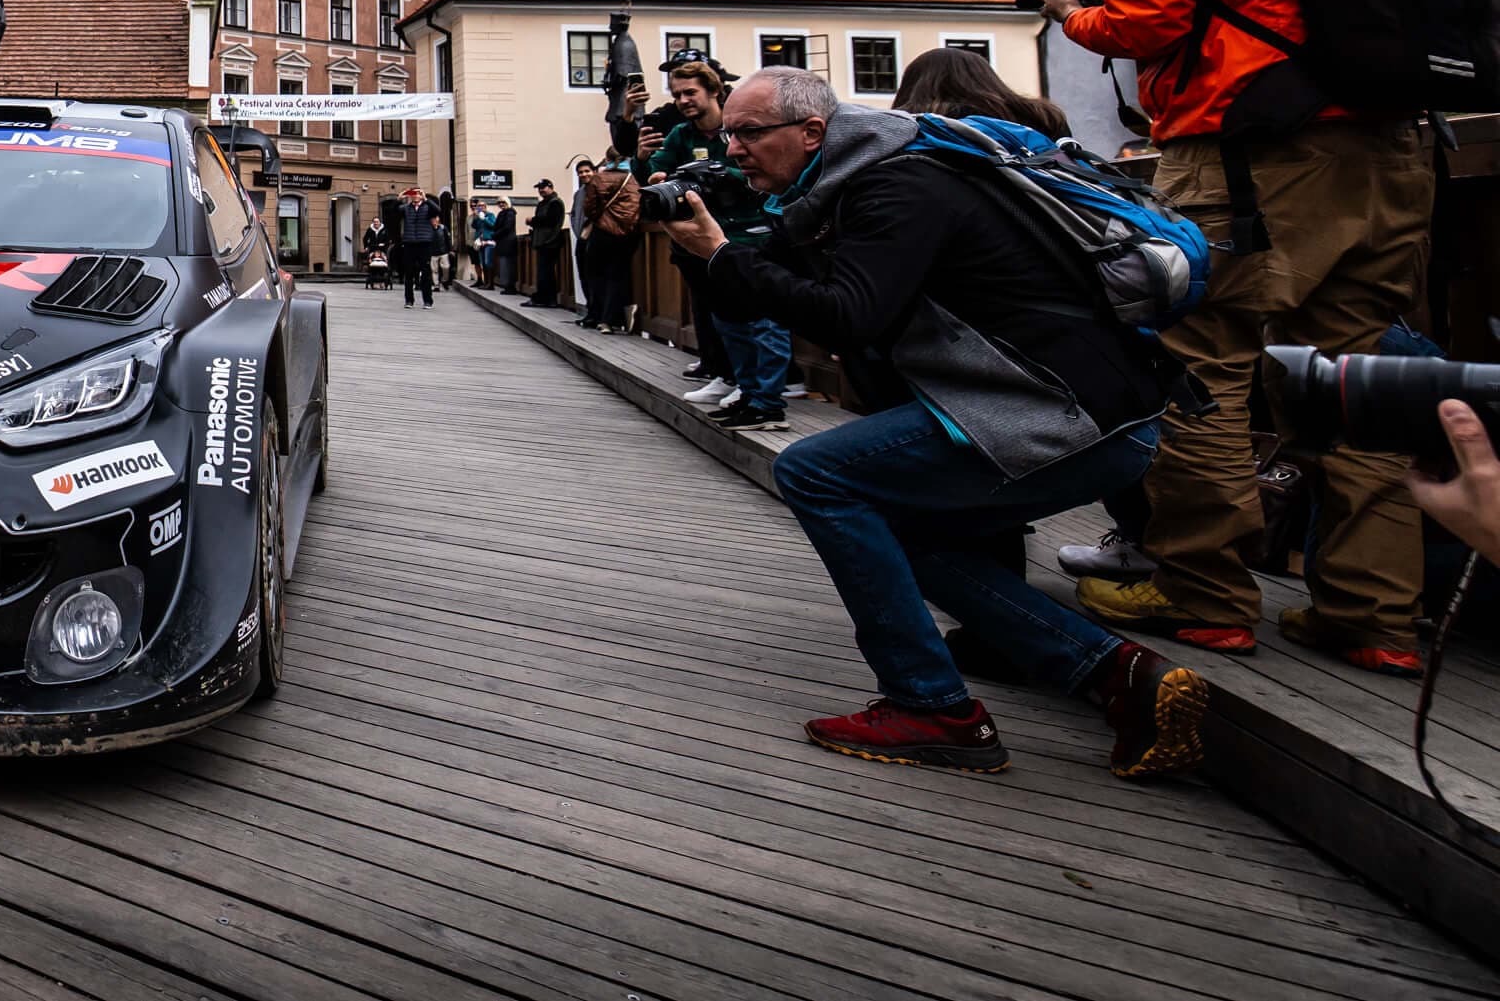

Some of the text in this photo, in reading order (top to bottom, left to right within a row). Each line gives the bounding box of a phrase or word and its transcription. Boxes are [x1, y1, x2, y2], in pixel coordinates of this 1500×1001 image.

[239, 98, 272, 108] Festival
[325, 98, 362, 108] Krumlov
[51, 123, 133, 137] Racing
[197, 357, 232, 487] Panasonic
[231, 357, 258, 495] AUTOMOTIVE
[150, 507, 182, 546] OMP
